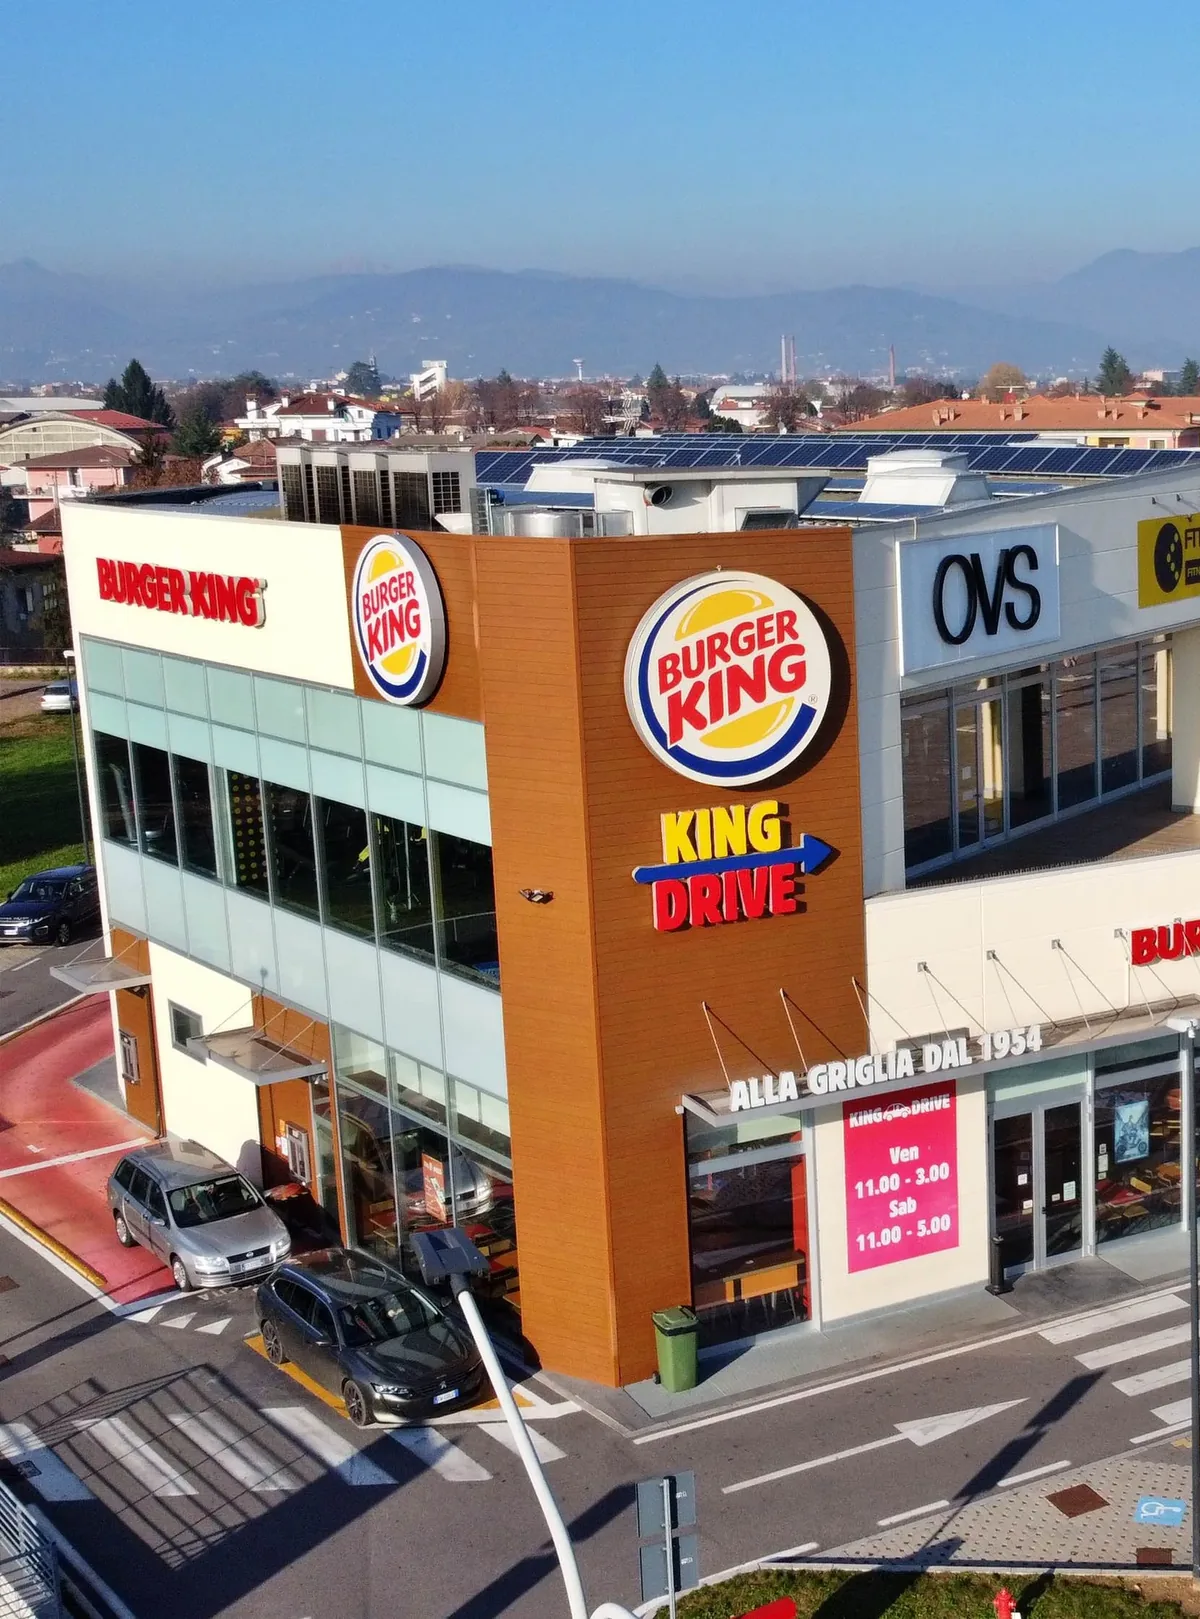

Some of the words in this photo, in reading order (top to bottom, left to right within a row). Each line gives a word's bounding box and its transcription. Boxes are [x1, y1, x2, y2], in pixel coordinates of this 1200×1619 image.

[96, 557, 189, 615] BURGER
[189, 570, 260, 627] KING
[362, 570, 416, 623] BURGER
[933, 545, 1041, 645] OVS
[367, 599, 421, 662] KING
[658, 610, 799, 695] BURGER
[667, 643, 807, 745] KING
[661, 800, 782, 864] KING
[652, 863, 797, 931] DRIVE
[730, 1071, 798, 1112] ALLA
[807, 1047, 914, 1096] GRIGLIA
[921, 1037, 973, 1073] DAL
[977, 1024, 1043, 1061] 1954
[849, 1107, 884, 1128] KING
[911, 1094, 951, 1116] DRIVE
[855, 1173, 900, 1199] 11.00
[915, 1162, 950, 1186] 3.00
[889, 1145, 919, 1165] Ven
[856, 1225, 902, 1252] 11.00
[917, 1214, 951, 1237] 5.00
[889, 1196, 917, 1218] Sab
